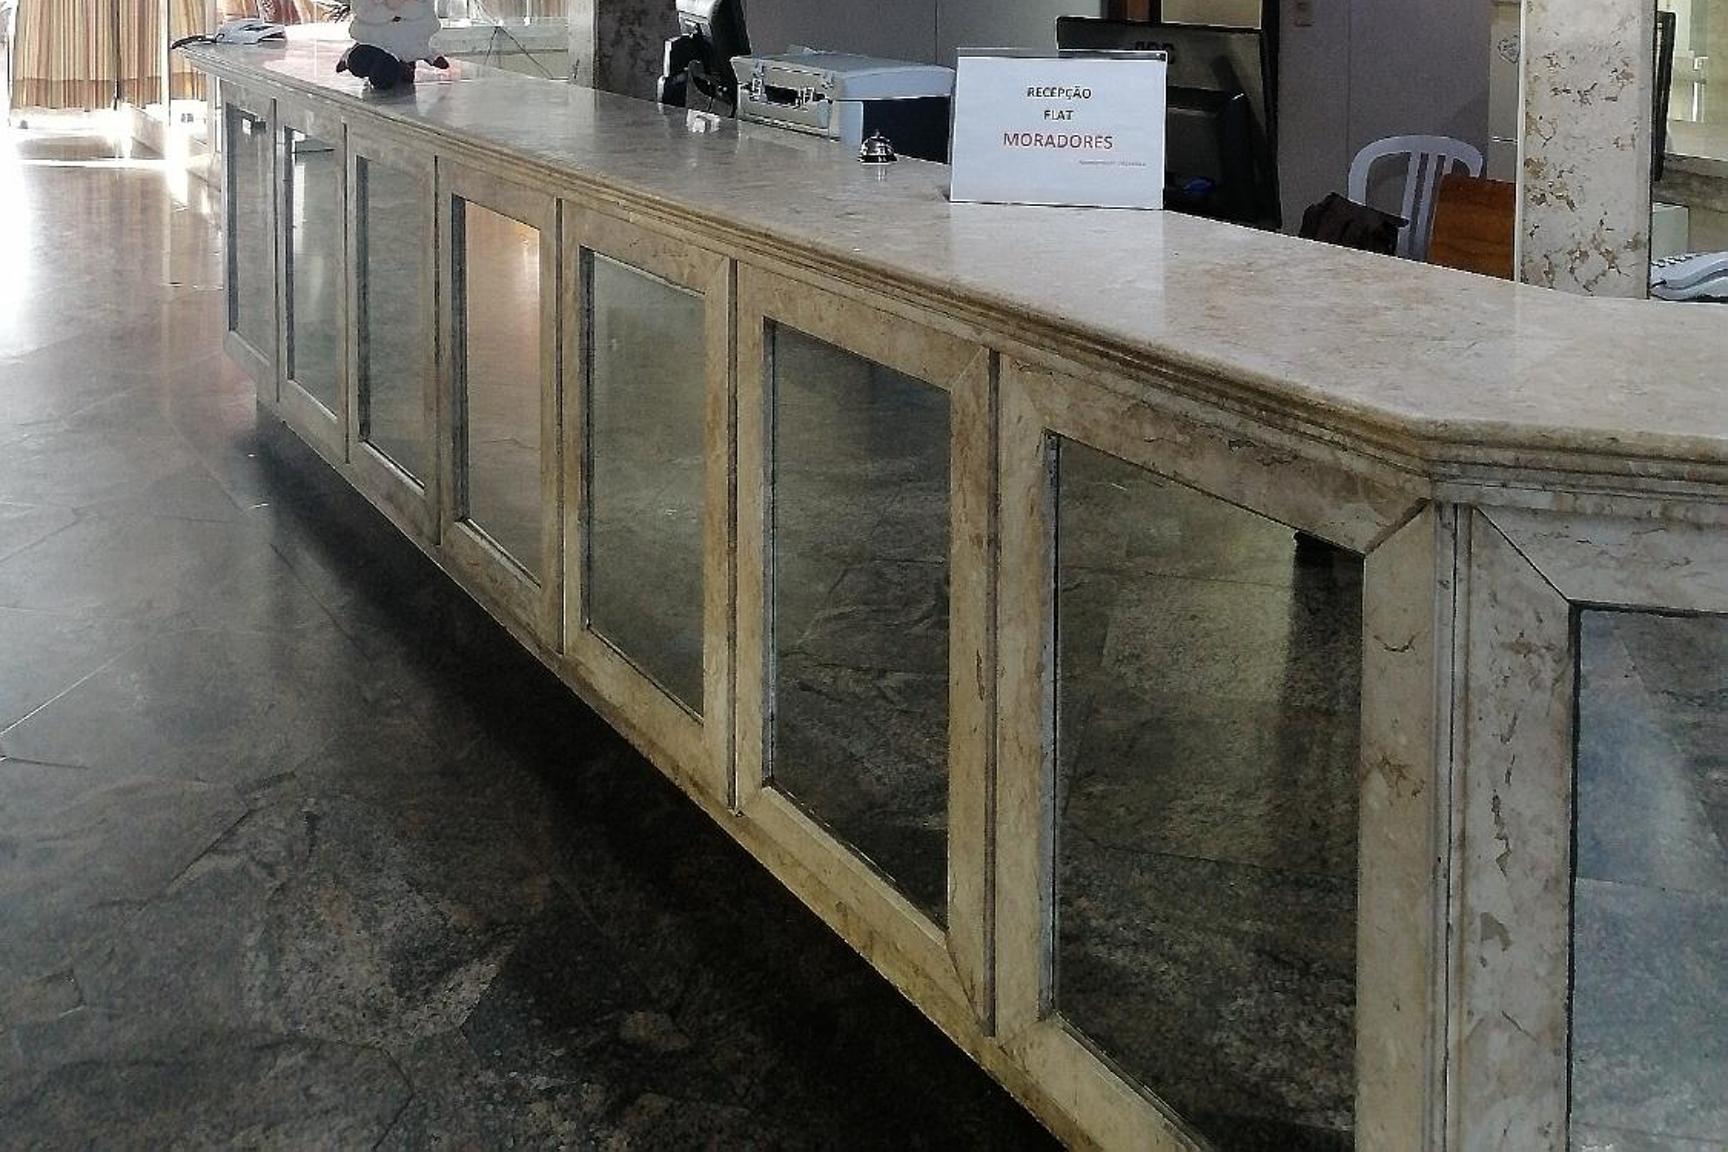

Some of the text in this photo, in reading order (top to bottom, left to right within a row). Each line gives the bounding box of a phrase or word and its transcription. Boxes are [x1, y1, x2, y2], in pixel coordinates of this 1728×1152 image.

[1027, 85, 1092, 100] RECEPÇÃO
[1043, 109, 1074, 121] FLAT
[1003, 132, 1113, 150] MORADORES
